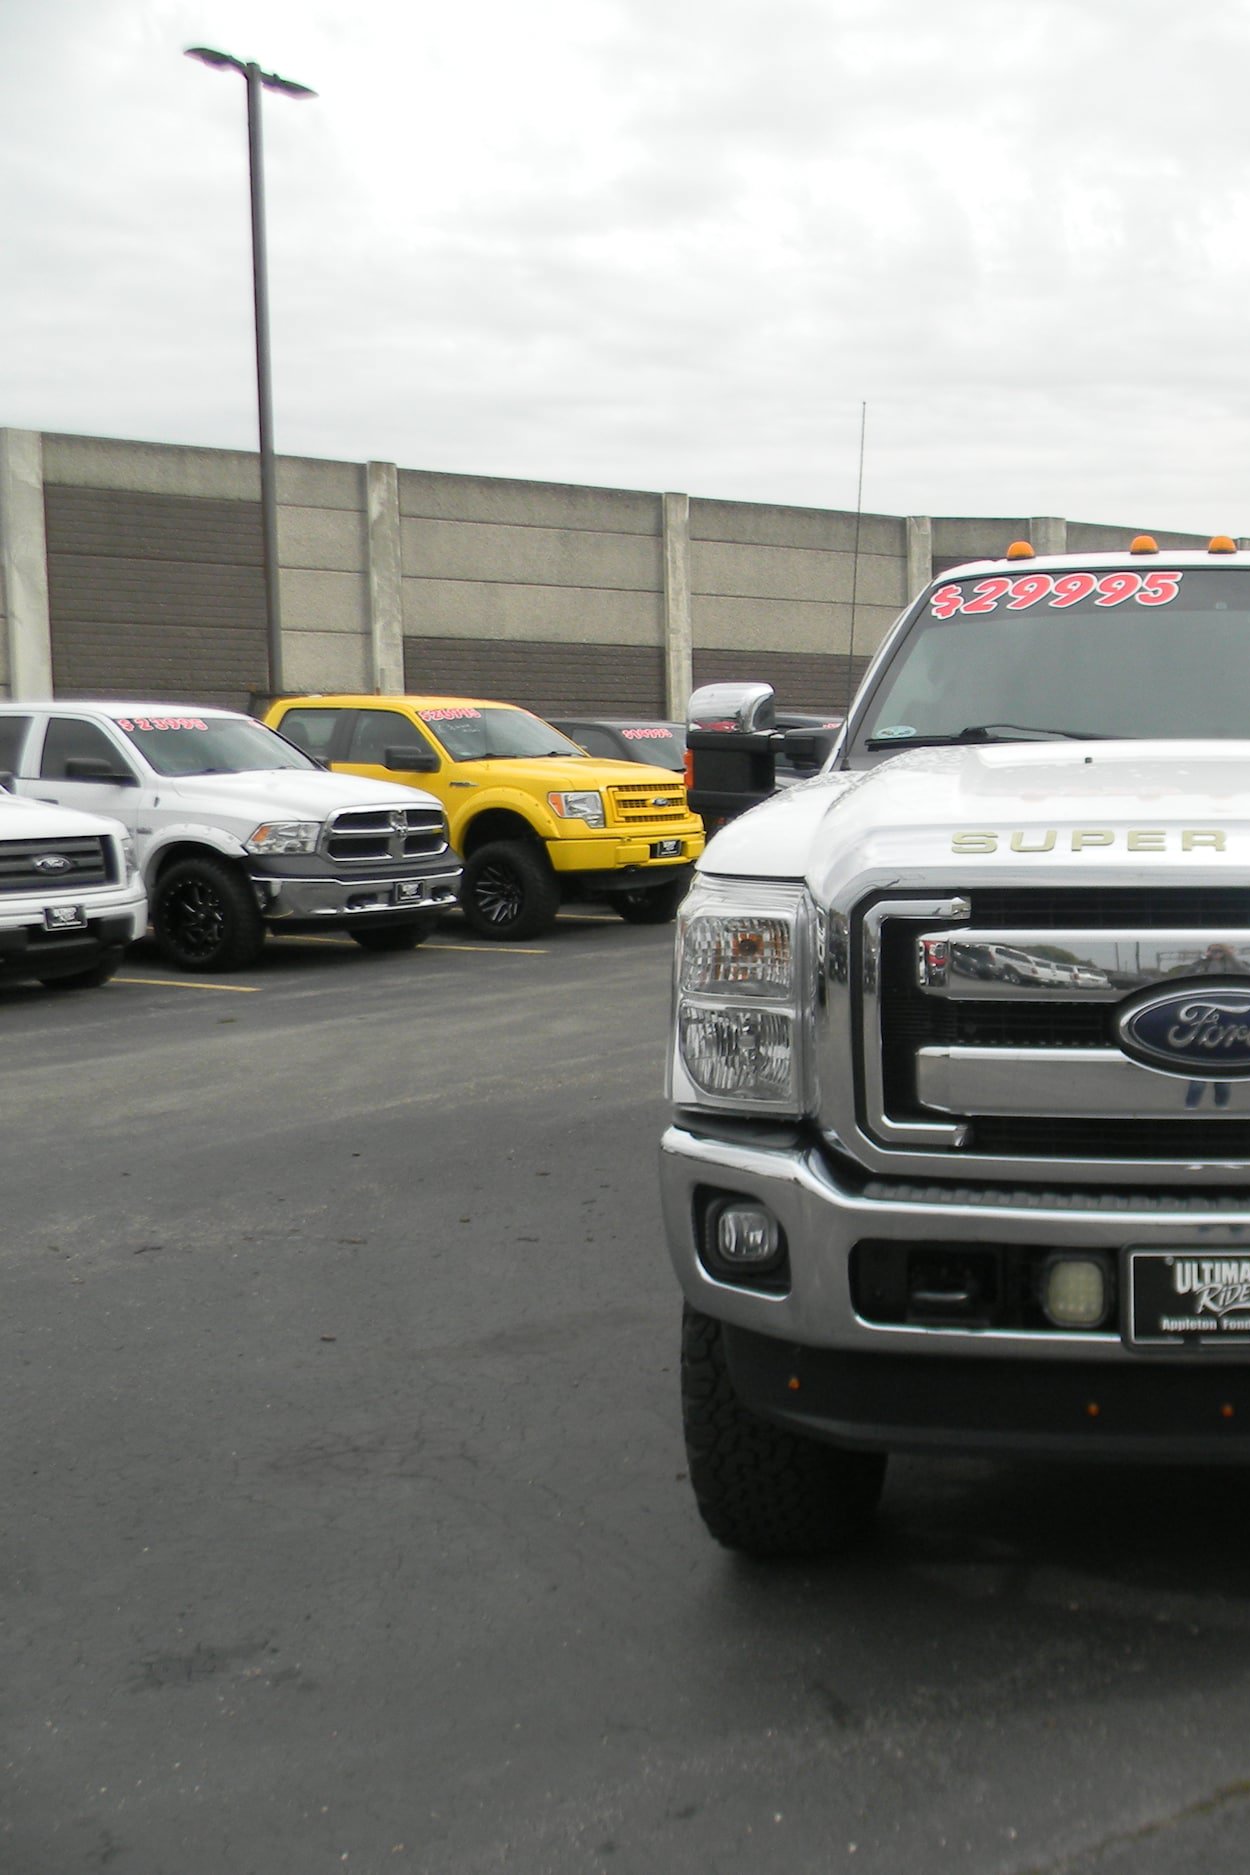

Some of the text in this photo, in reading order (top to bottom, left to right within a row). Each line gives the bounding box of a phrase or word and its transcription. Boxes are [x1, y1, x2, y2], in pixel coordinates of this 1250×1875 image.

[931, 571, 1183, 620] $29995
[951, 830, 1227, 853] SUPER
[1161, 1316, 1218, 1331] Appleton
